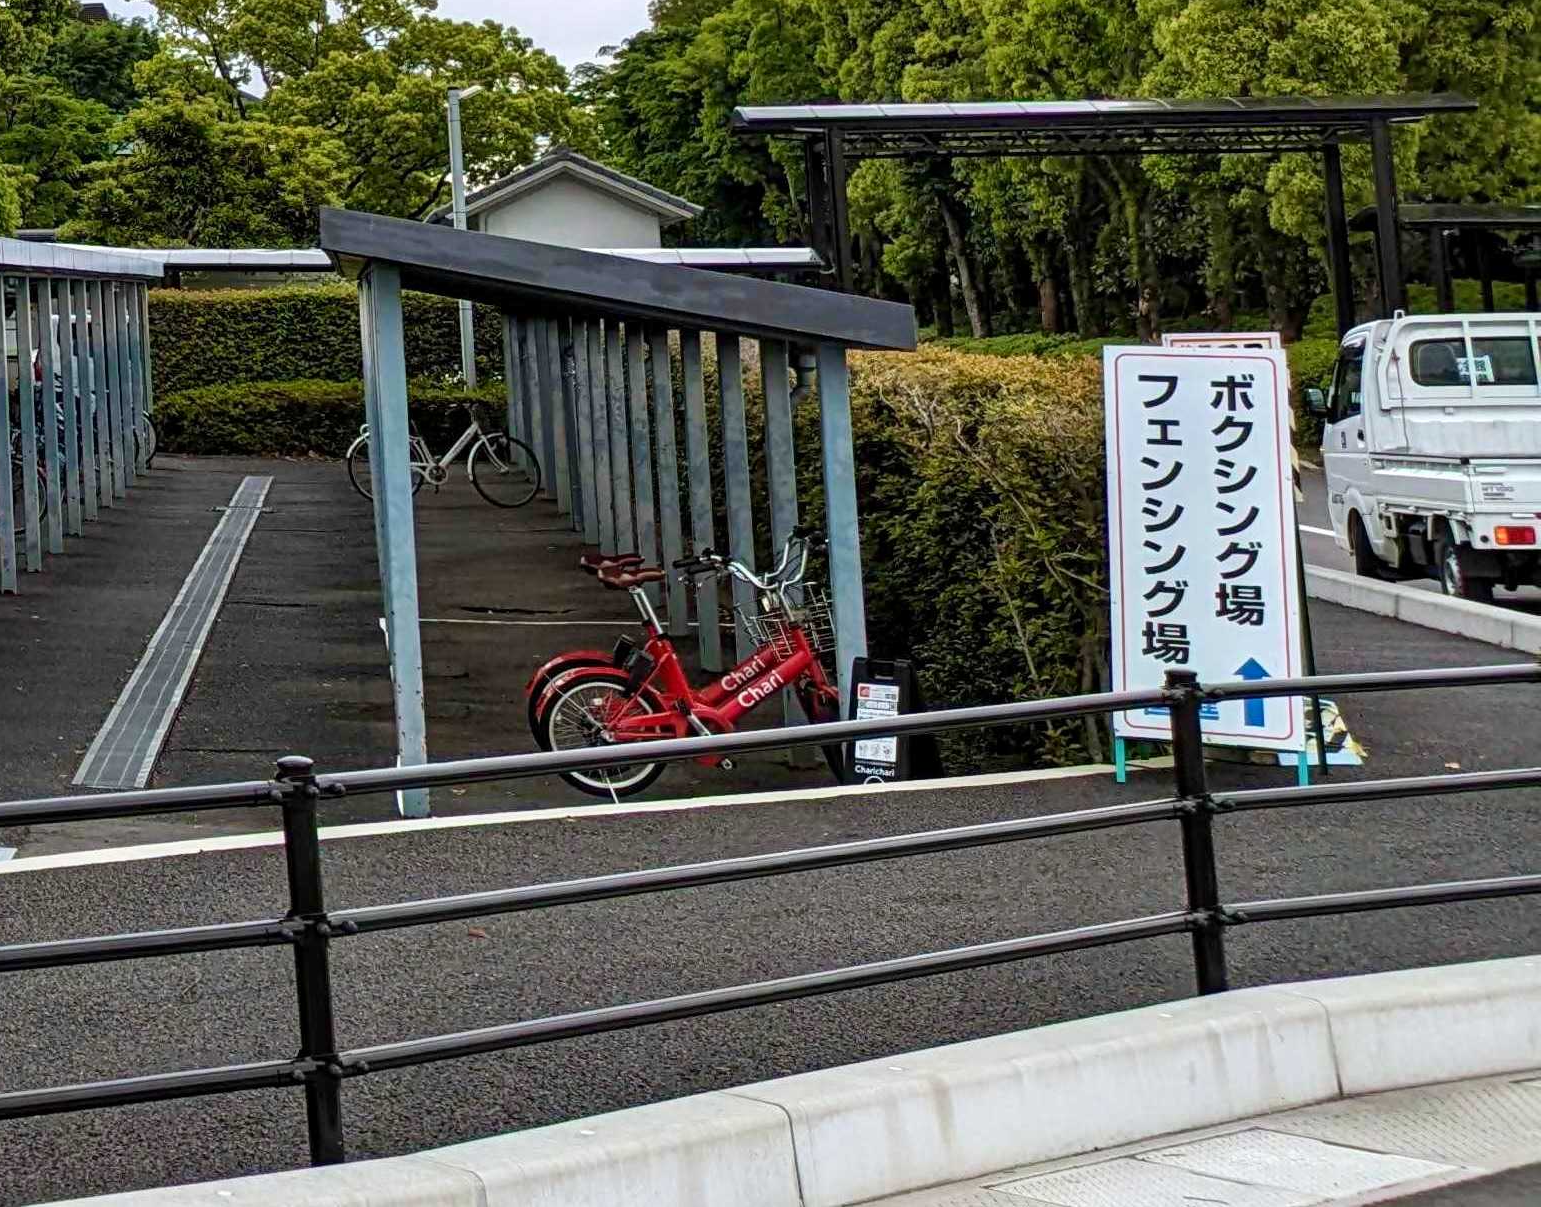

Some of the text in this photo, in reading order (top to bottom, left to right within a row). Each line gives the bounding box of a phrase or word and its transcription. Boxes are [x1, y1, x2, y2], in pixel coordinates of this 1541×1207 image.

[1210, 373, 1266, 626] ボクシング場
[1138, 374, 1191, 665] フェンシング場
[721, 655, 766, 691] Chari
[737, 669, 784, 707] Chari
[854, 764, 895, 778] Charichari
